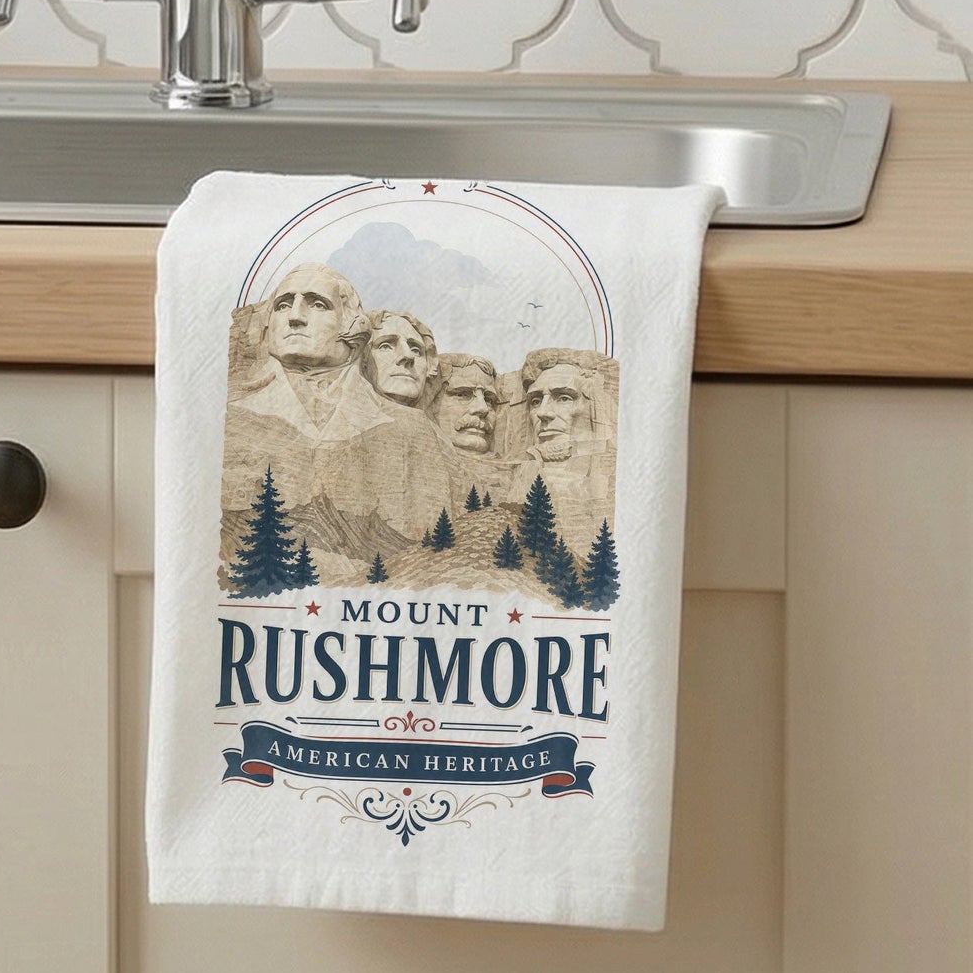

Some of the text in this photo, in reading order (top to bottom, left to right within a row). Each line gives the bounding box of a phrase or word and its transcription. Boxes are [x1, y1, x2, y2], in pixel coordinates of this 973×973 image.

[340, 599, 488, 627] MOUNT
[214, 617, 611, 723] RUSHMORE
[267, 740, 552, 772] AMERICAN HERITAGE
